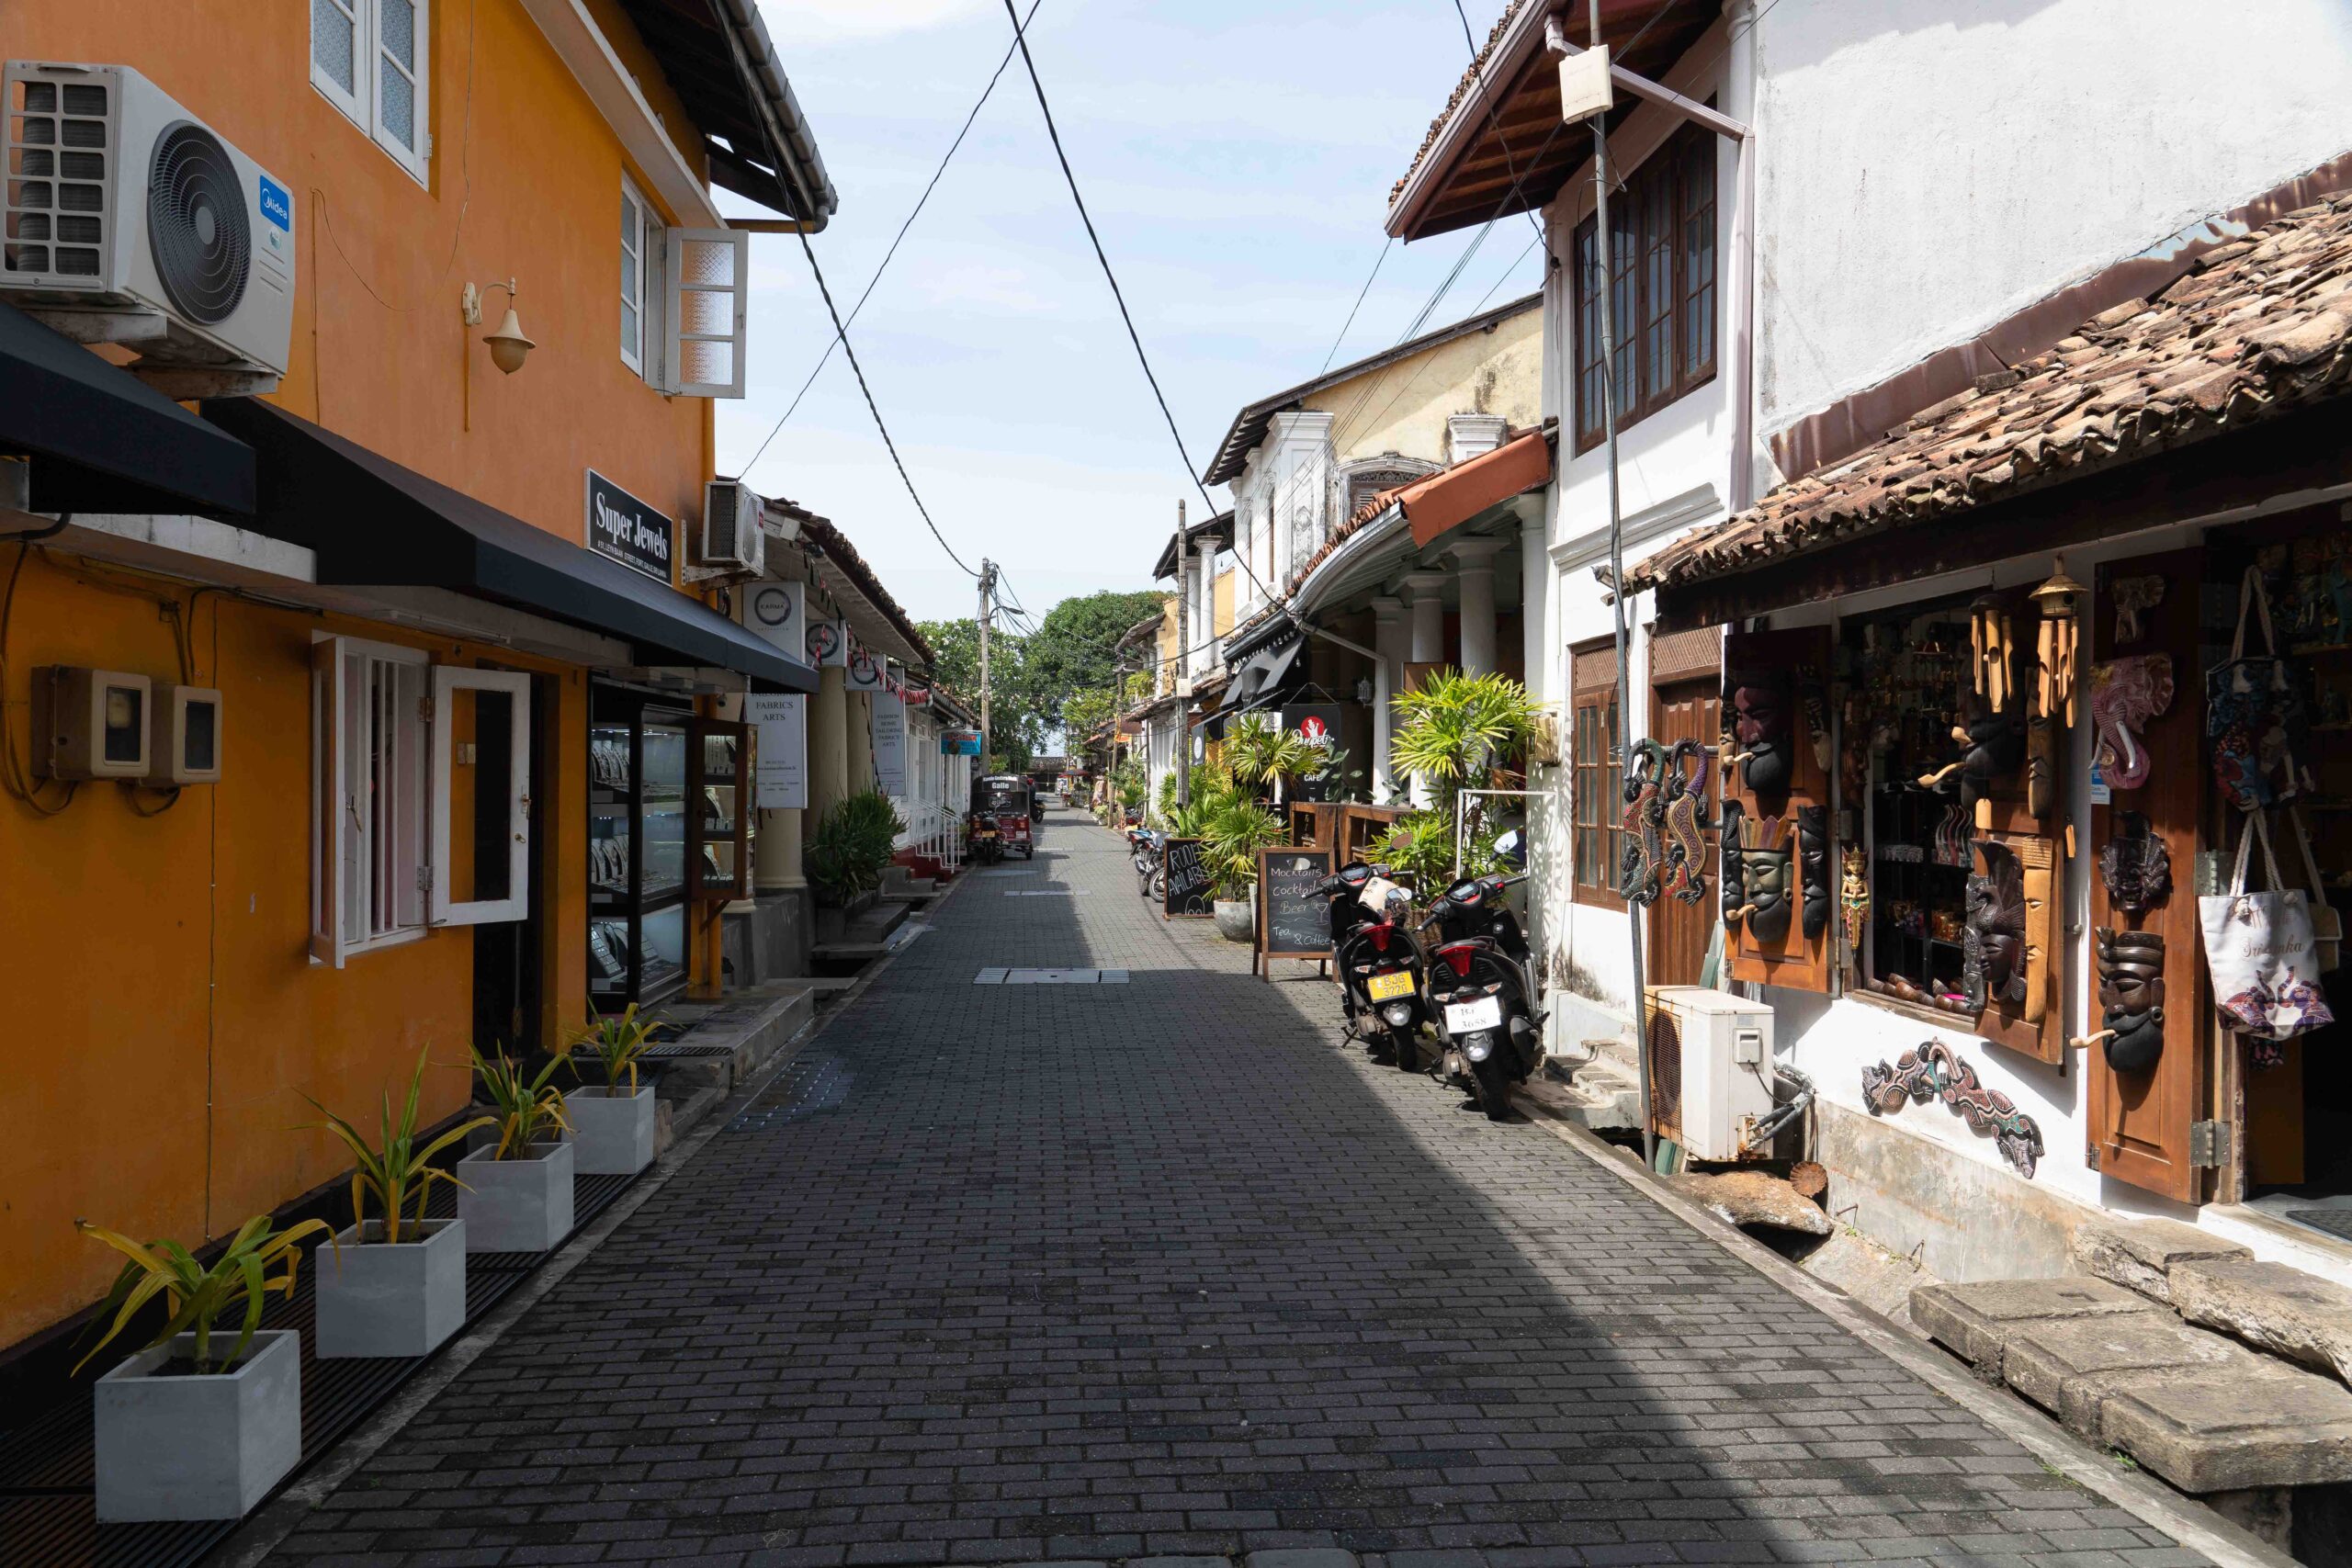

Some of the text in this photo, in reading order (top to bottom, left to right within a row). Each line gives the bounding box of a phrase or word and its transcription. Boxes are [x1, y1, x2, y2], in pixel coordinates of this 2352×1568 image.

[262, 188, 287, 220] Midea
[596, 492, 667, 560] Super Jewels
[757, 701, 794, 709] FABRICS
[763, 713, 786, 721] ARTS
[1280, 900, 1309, 914] Beer
[1384, 974, 1406, 986] BJG
[1384, 984, 1408, 997] 3770
